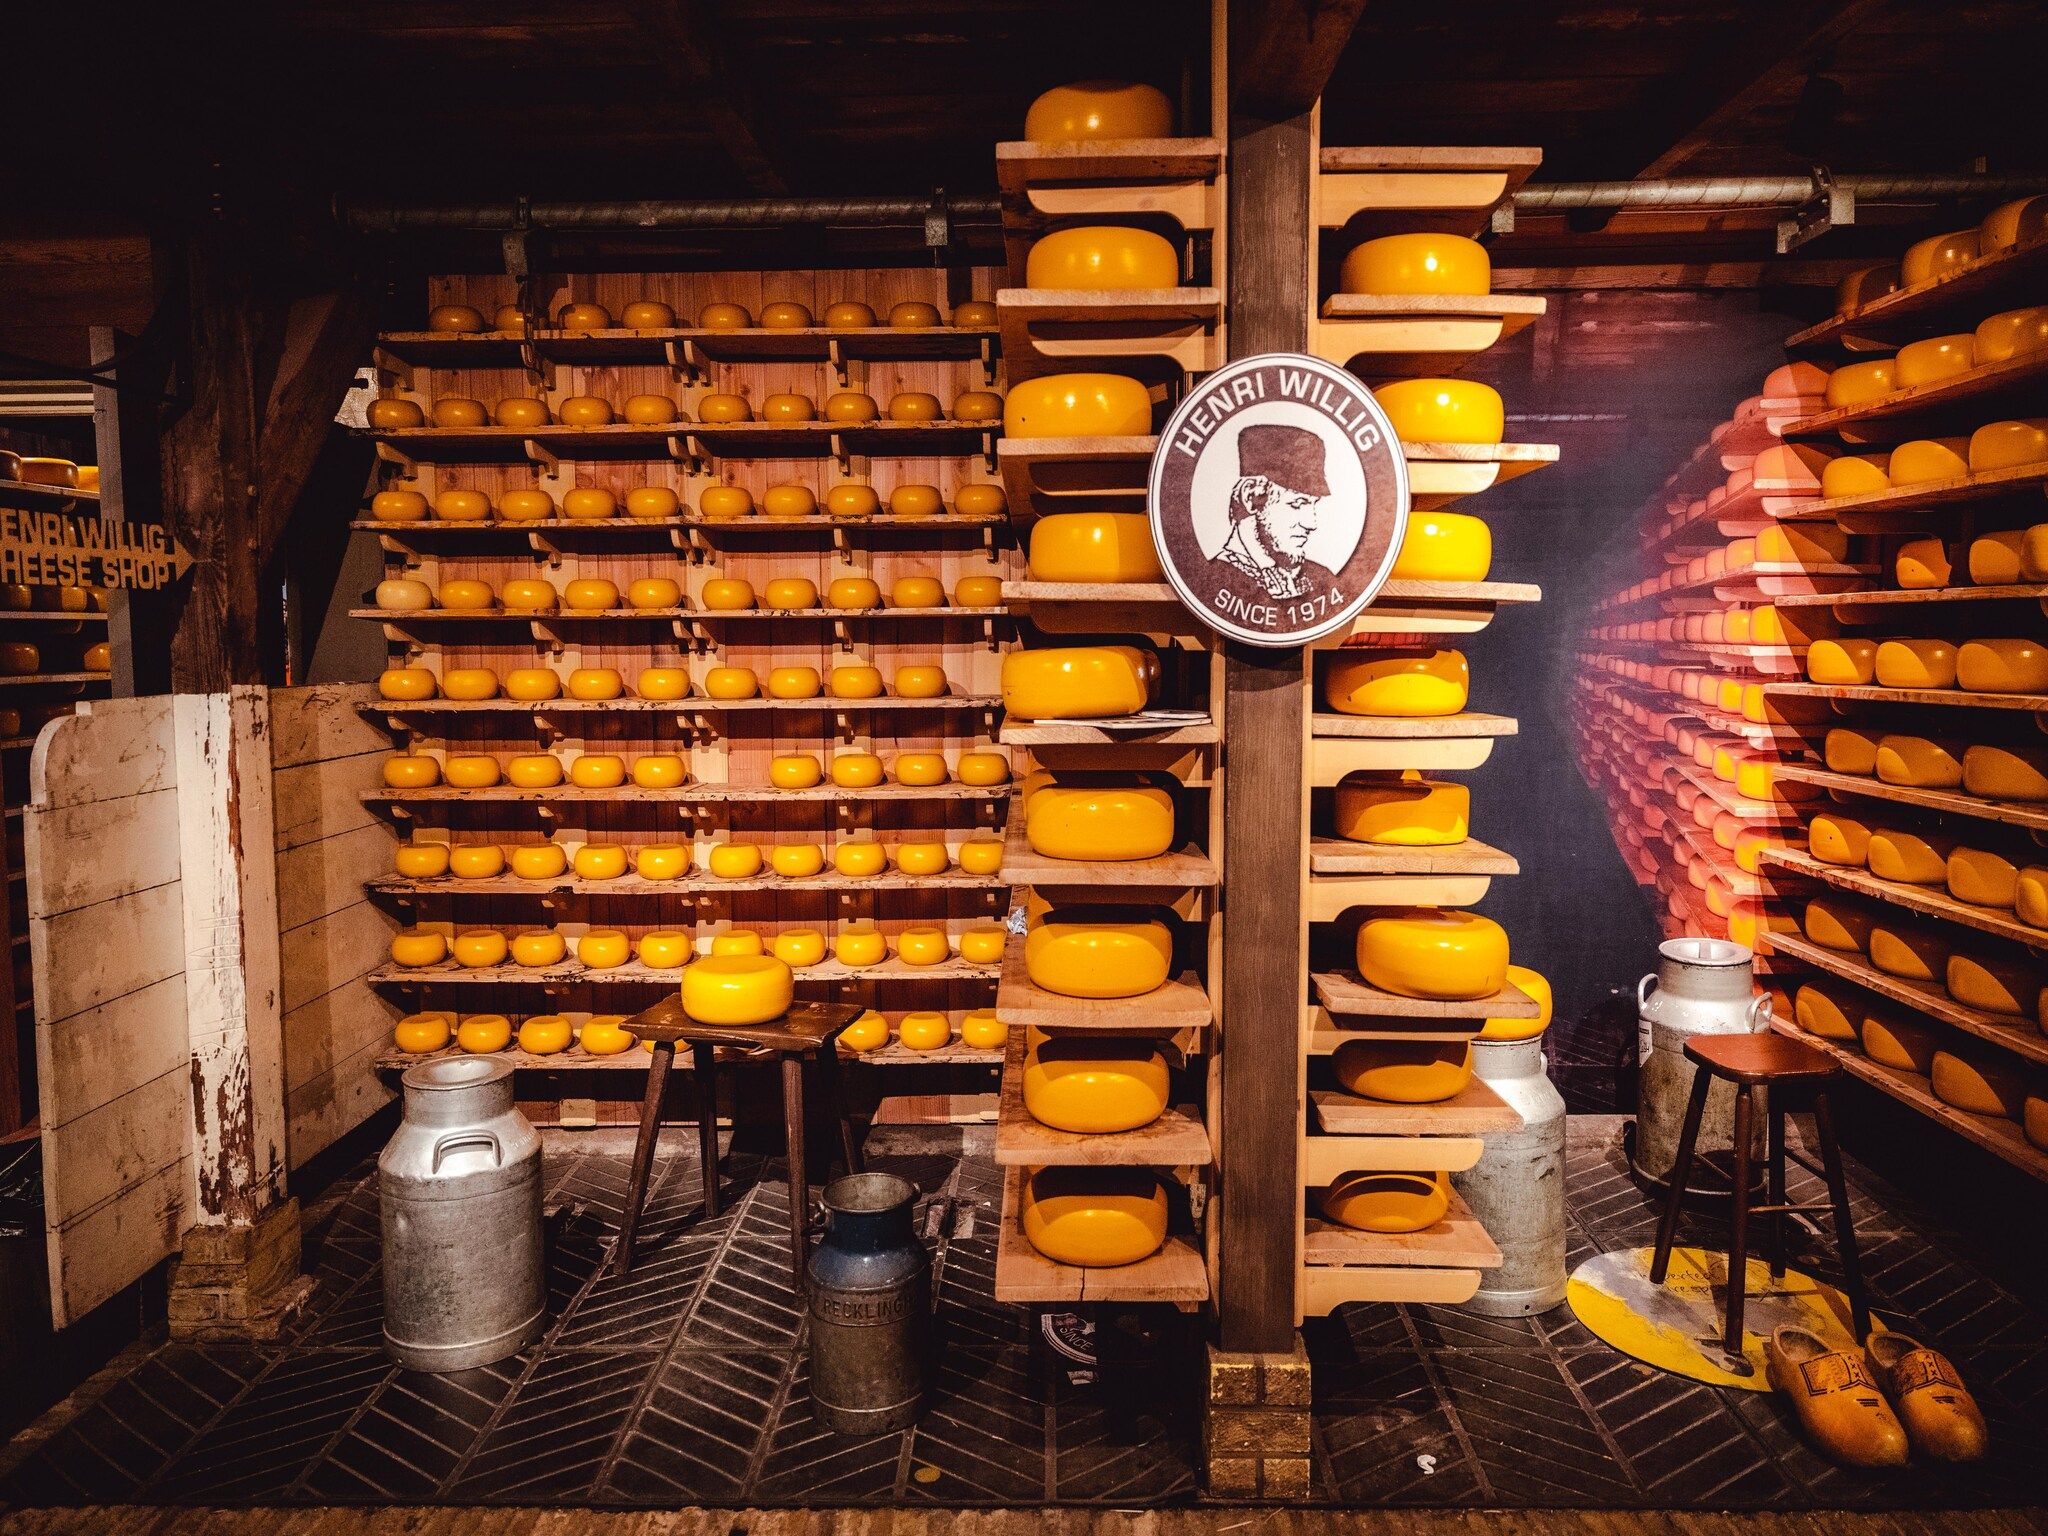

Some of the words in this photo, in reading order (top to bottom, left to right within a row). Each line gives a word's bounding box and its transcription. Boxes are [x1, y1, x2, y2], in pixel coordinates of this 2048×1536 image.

[1176, 371, 1265, 458] HENRI
[1280, 369, 1379, 453] WILLIG
[77, 516, 165, 553] WILLIG
[102, 556, 170, 591] SHOP
[1214, 588, 1277, 626] SINCE
[1288, 587, 1345, 625] 1974
